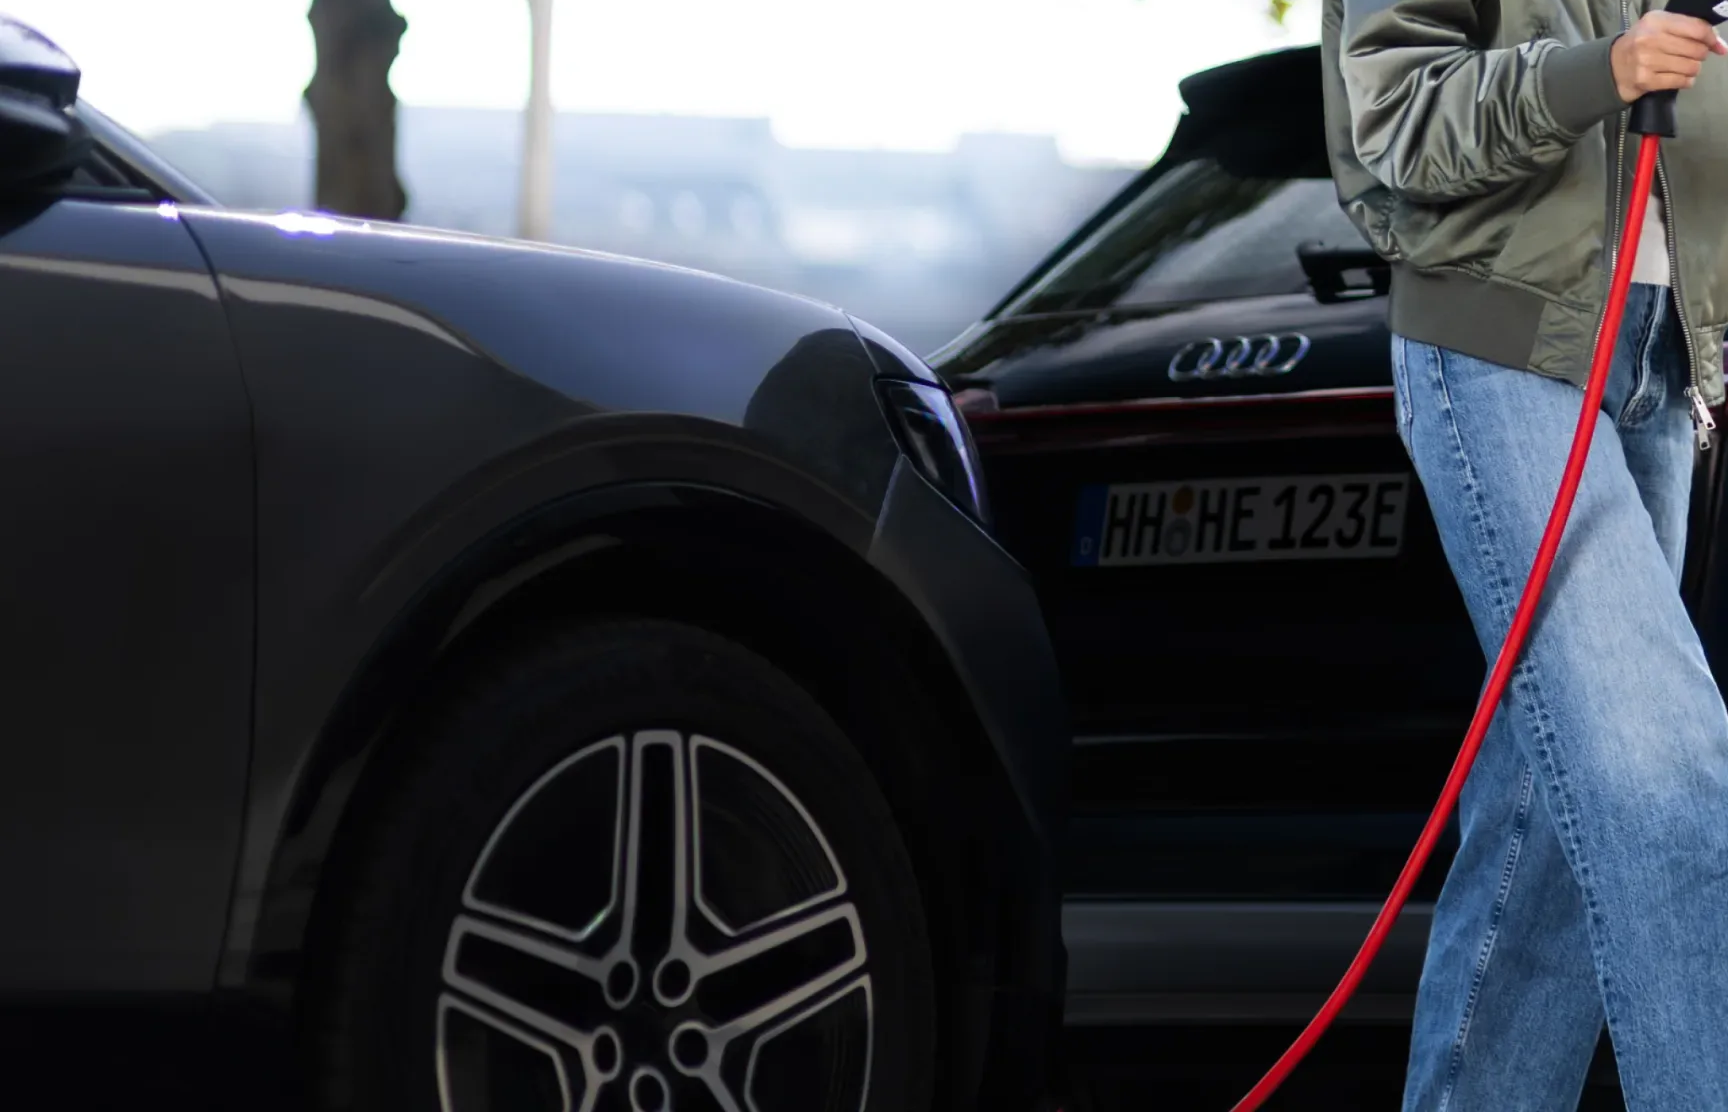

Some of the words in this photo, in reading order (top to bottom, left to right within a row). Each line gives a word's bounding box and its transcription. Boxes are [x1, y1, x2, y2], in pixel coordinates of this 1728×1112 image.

[1103, 492, 1167, 558] HH
[1195, 486, 1261, 552] HE
[1268, 481, 1404, 551] 123E
